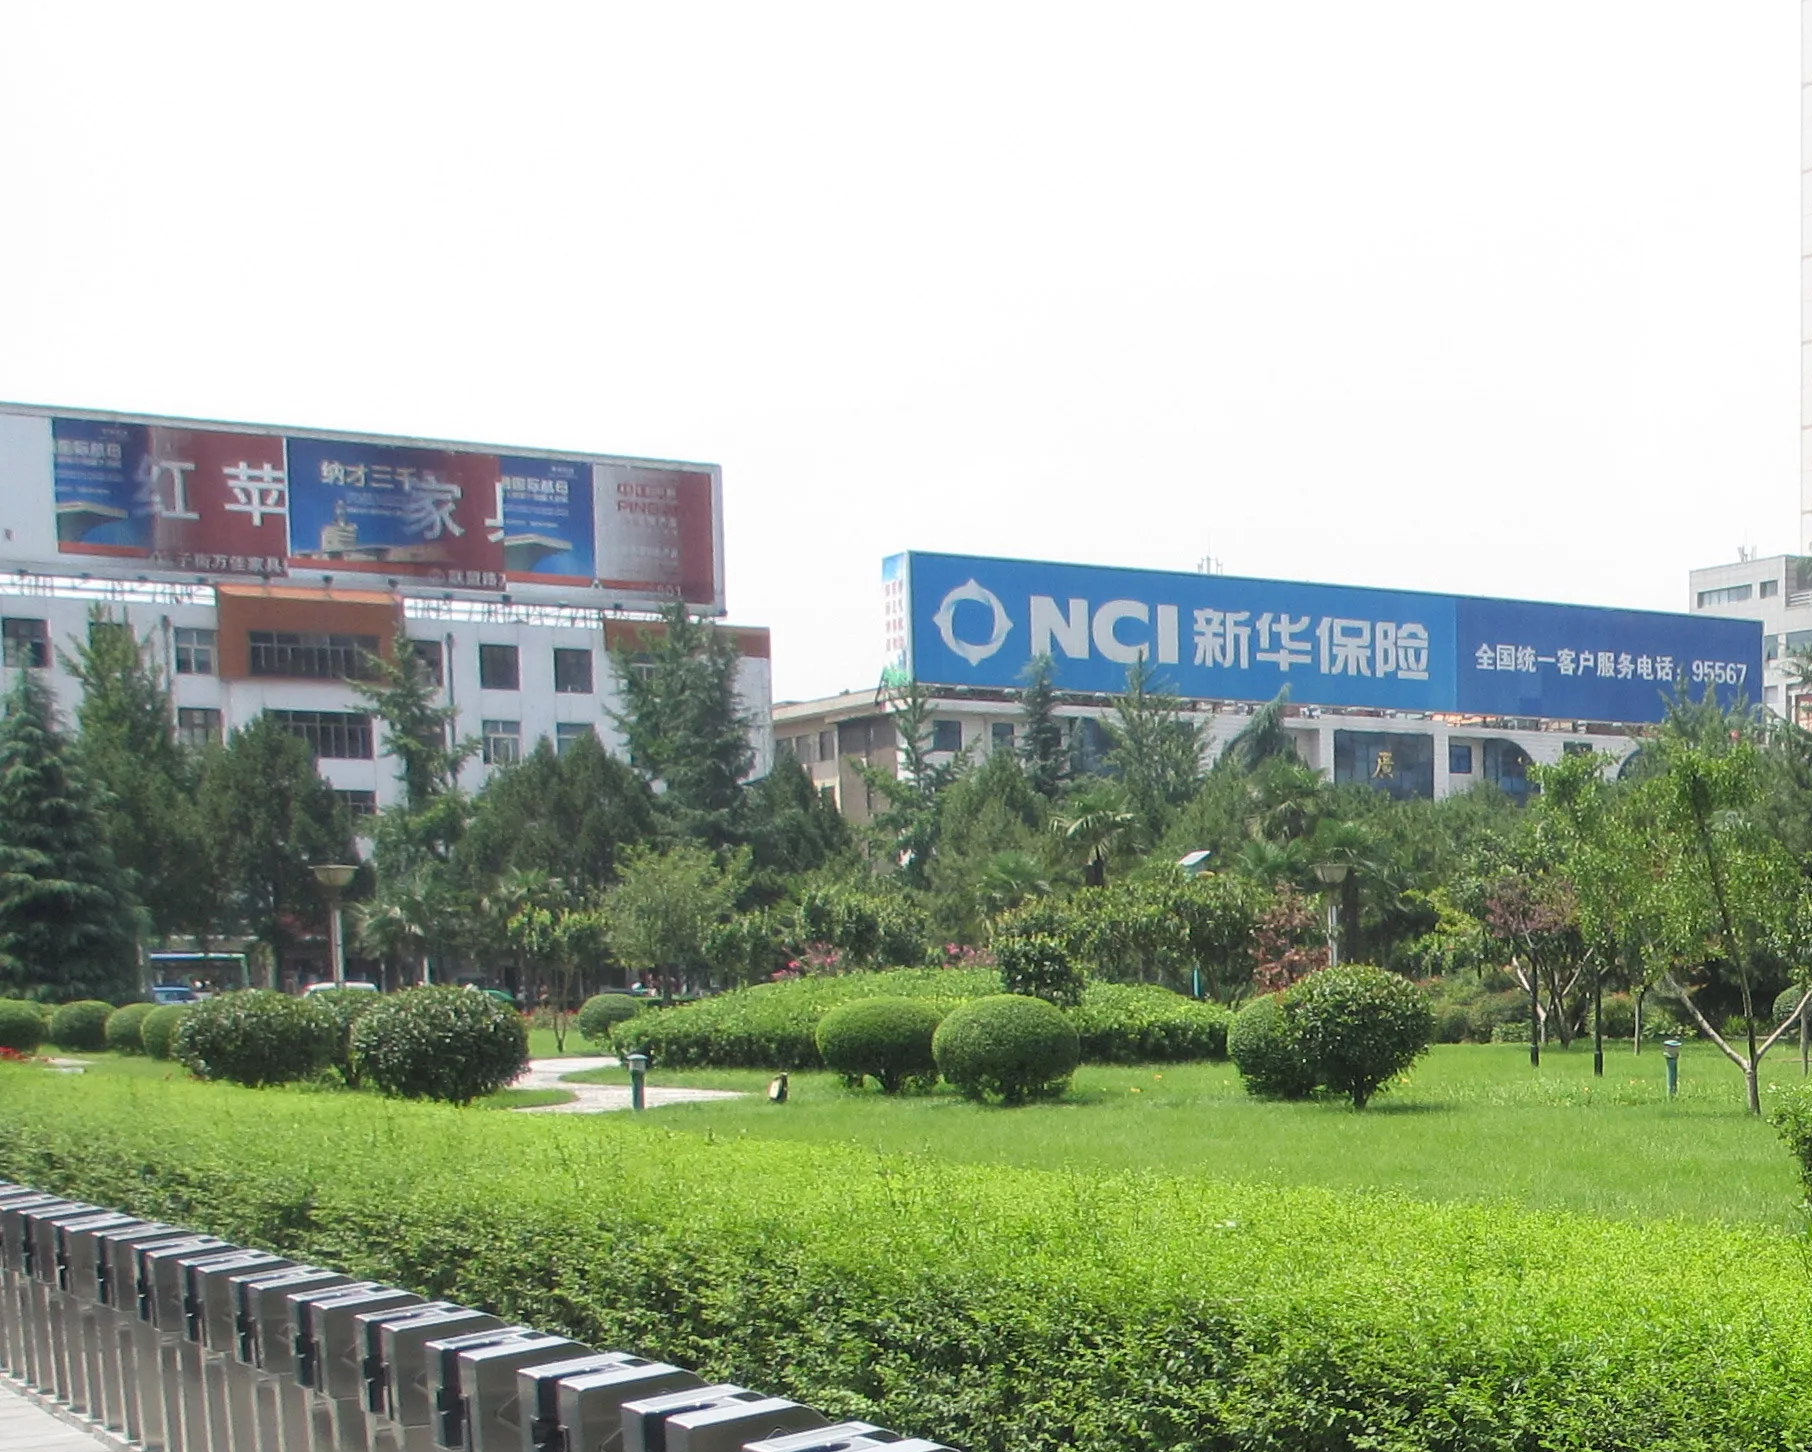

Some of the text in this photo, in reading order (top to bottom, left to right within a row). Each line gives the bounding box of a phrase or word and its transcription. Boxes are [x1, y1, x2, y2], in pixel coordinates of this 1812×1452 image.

[1030, 596, 1179, 664] NCI
[1193, 608, 1429, 680] 新华保险
